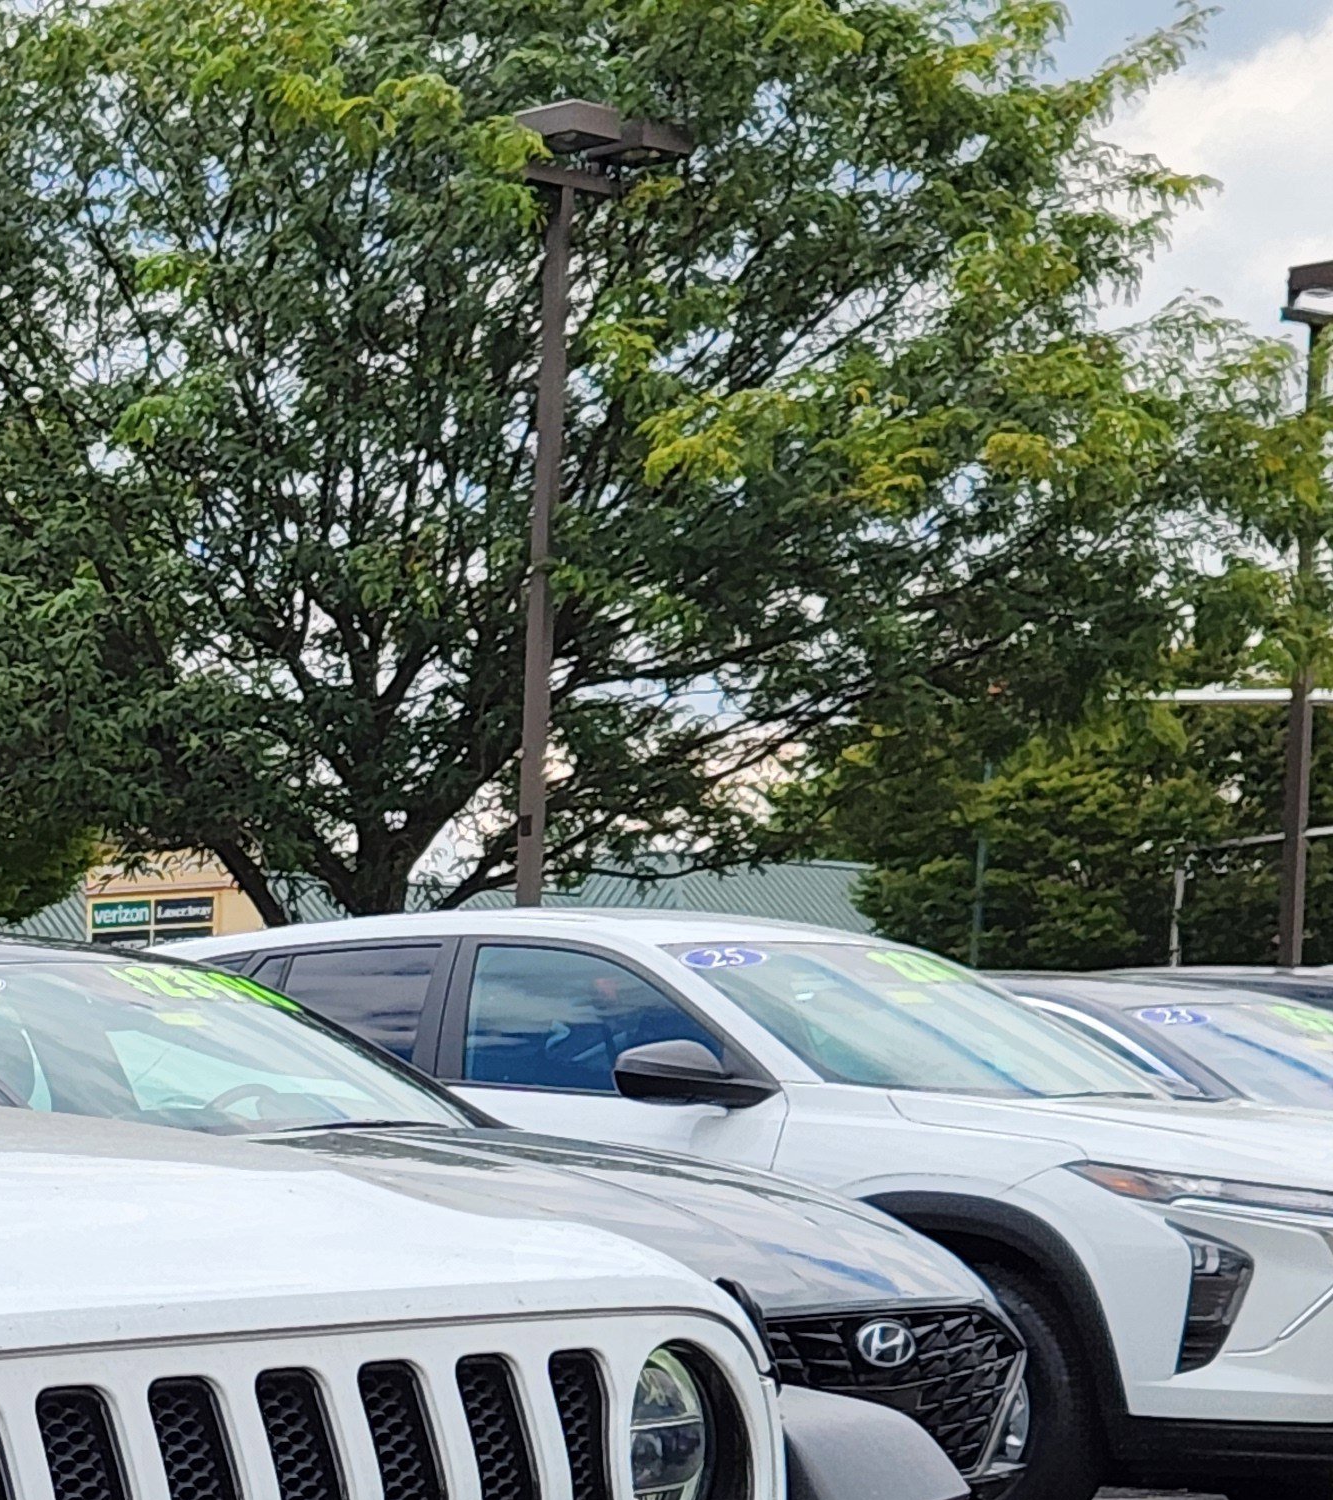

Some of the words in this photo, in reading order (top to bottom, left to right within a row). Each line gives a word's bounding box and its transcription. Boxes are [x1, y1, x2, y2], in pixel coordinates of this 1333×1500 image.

[94, 904, 149, 924] verizon
[704, 951, 745, 967] 25
[1155, 1007, 1192, 1024] 23
